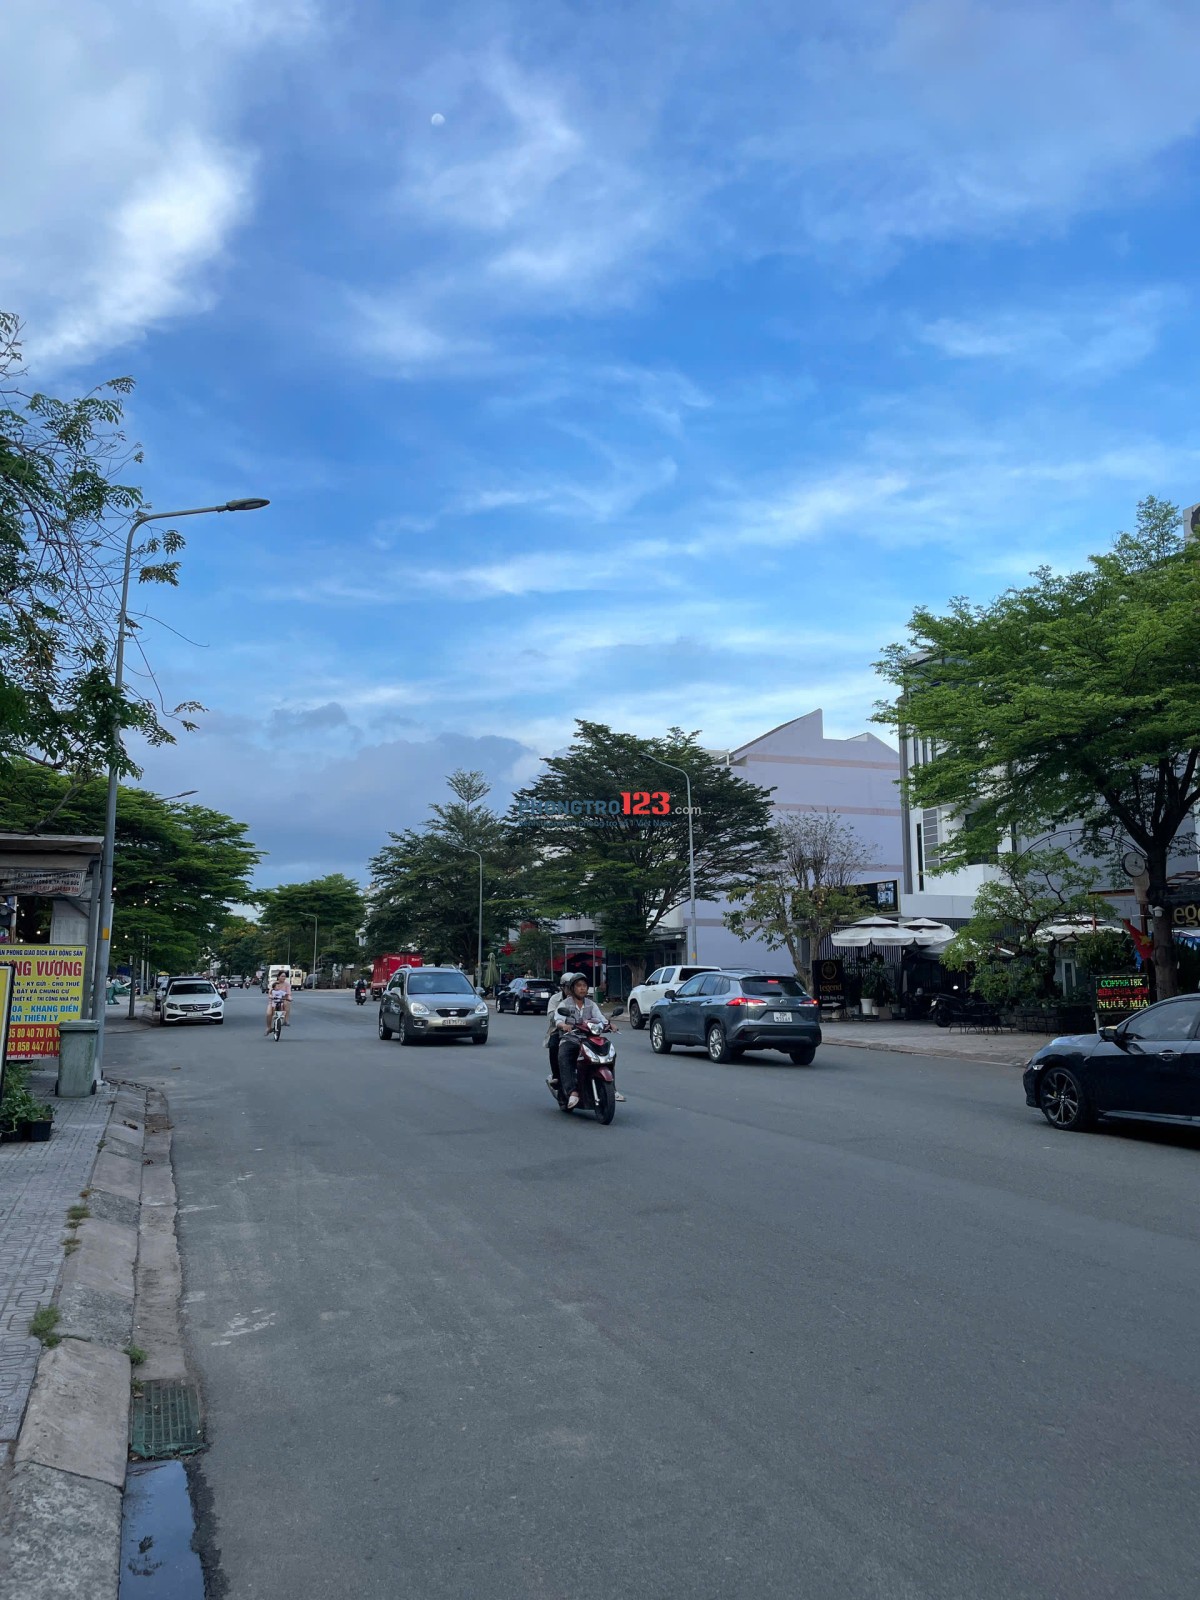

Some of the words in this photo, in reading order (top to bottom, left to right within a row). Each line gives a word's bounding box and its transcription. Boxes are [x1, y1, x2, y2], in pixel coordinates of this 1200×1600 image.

[36, 960, 83, 980] VƯỢNG
[30, 1005, 58, 1013] KHANG
[27, 1028, 35, 1038] 40
[36, 1028, 44, 1038] 70
[32, 1042, 45, 1051] 447
